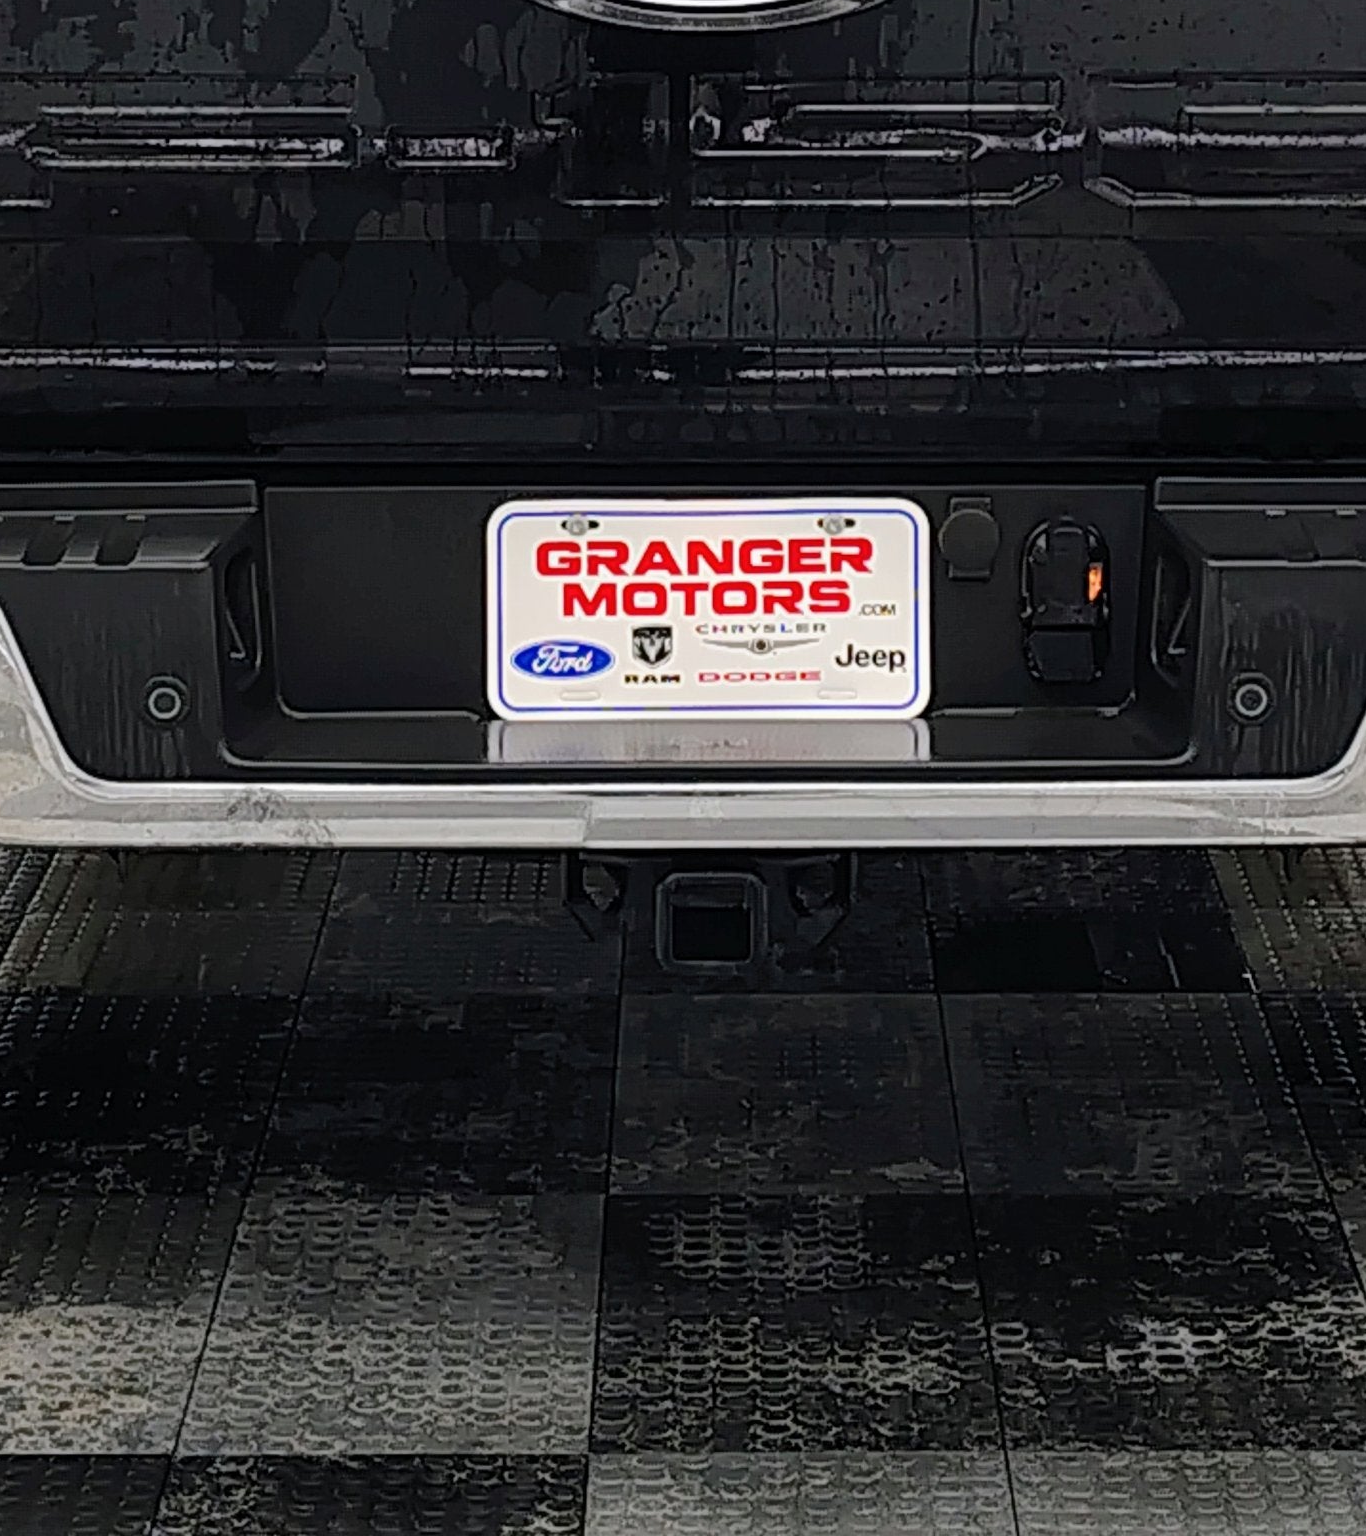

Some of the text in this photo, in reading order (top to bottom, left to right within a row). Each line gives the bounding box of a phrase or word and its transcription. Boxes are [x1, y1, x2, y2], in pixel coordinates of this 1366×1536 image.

[536, 537, 873, 576] GRANGER
[563, 580, 896, 616] MOTORS .COM
[695, 623, 827, 635] CHRYSLER
[531, 644, 593, 673] Ford
[835, 643, 906, 672] Jeep
[624, 674, 681, 683] RAM
[698, 671, 821, 682] DODGE
